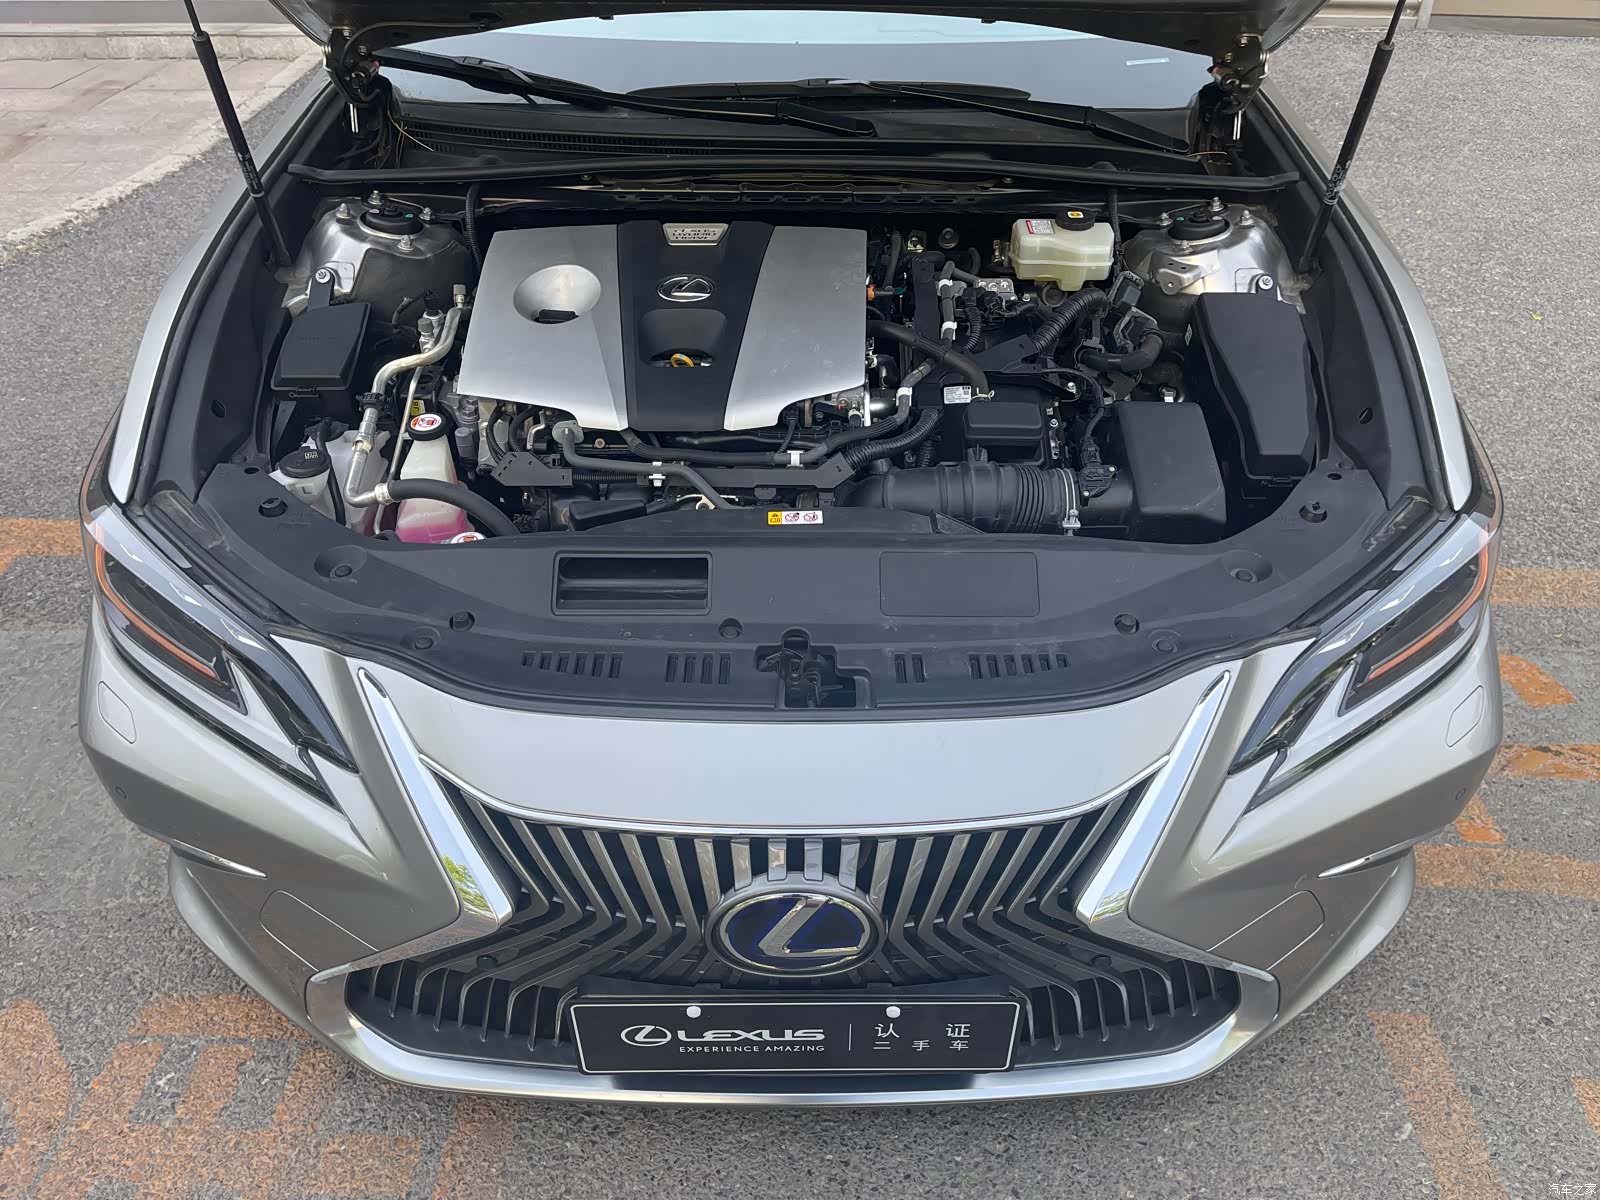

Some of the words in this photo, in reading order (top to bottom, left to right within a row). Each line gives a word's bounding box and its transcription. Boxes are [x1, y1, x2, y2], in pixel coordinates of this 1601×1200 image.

[677, 1028, 826, 1042] LEXUS
[874, 1022, 972, 1038] 认证
[679, 1045, 760, 1054] EXPERIENCE
[763, 1045, 825, 1053] AMAZING
[872, 1039, 970, 1052] 二手车
